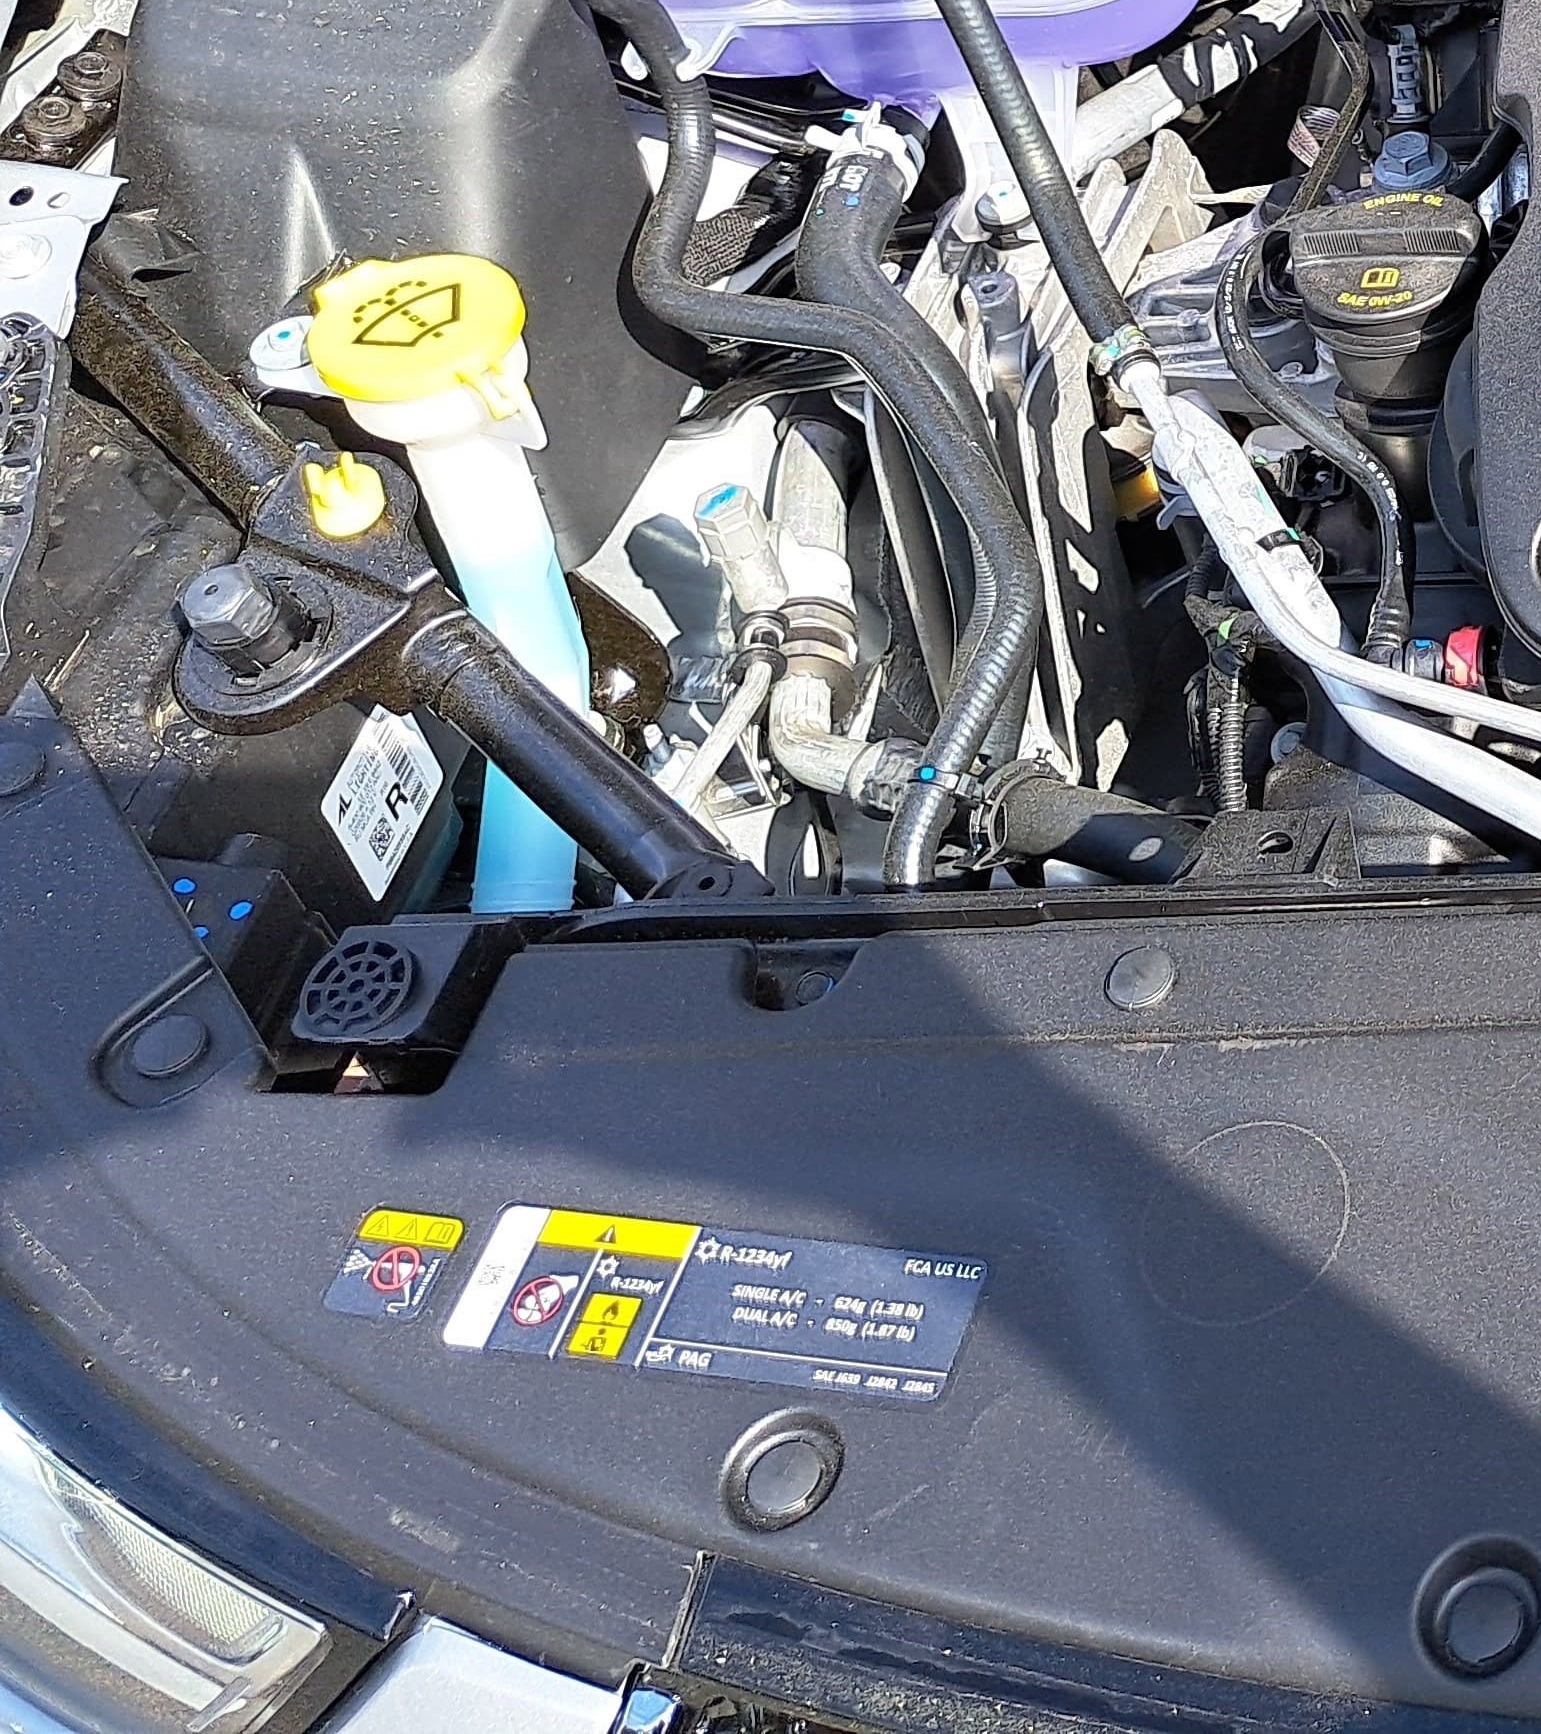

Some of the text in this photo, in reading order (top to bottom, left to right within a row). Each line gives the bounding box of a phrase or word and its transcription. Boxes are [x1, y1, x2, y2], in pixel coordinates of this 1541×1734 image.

[1362, 192, 1445, 210] ENGINE OIL
[1336, 290, 1413, 307] SAE 0W-20
[384, 780, 409, 821] R
[719, 1246, 793, 1271] R-1234yf
[904, 1258, 984, 1280] FCA US LLC
[731, 1284, 778, 1303] SINGLE
[779, 1287, 808, 1307] A/C
[732, 1307, 770, 1325] DUAL
[770, 1310, 799, 1328] A/C
[678, 1349, 713, 1370] PAG
[811, 1368, 834, 1381] SAE
